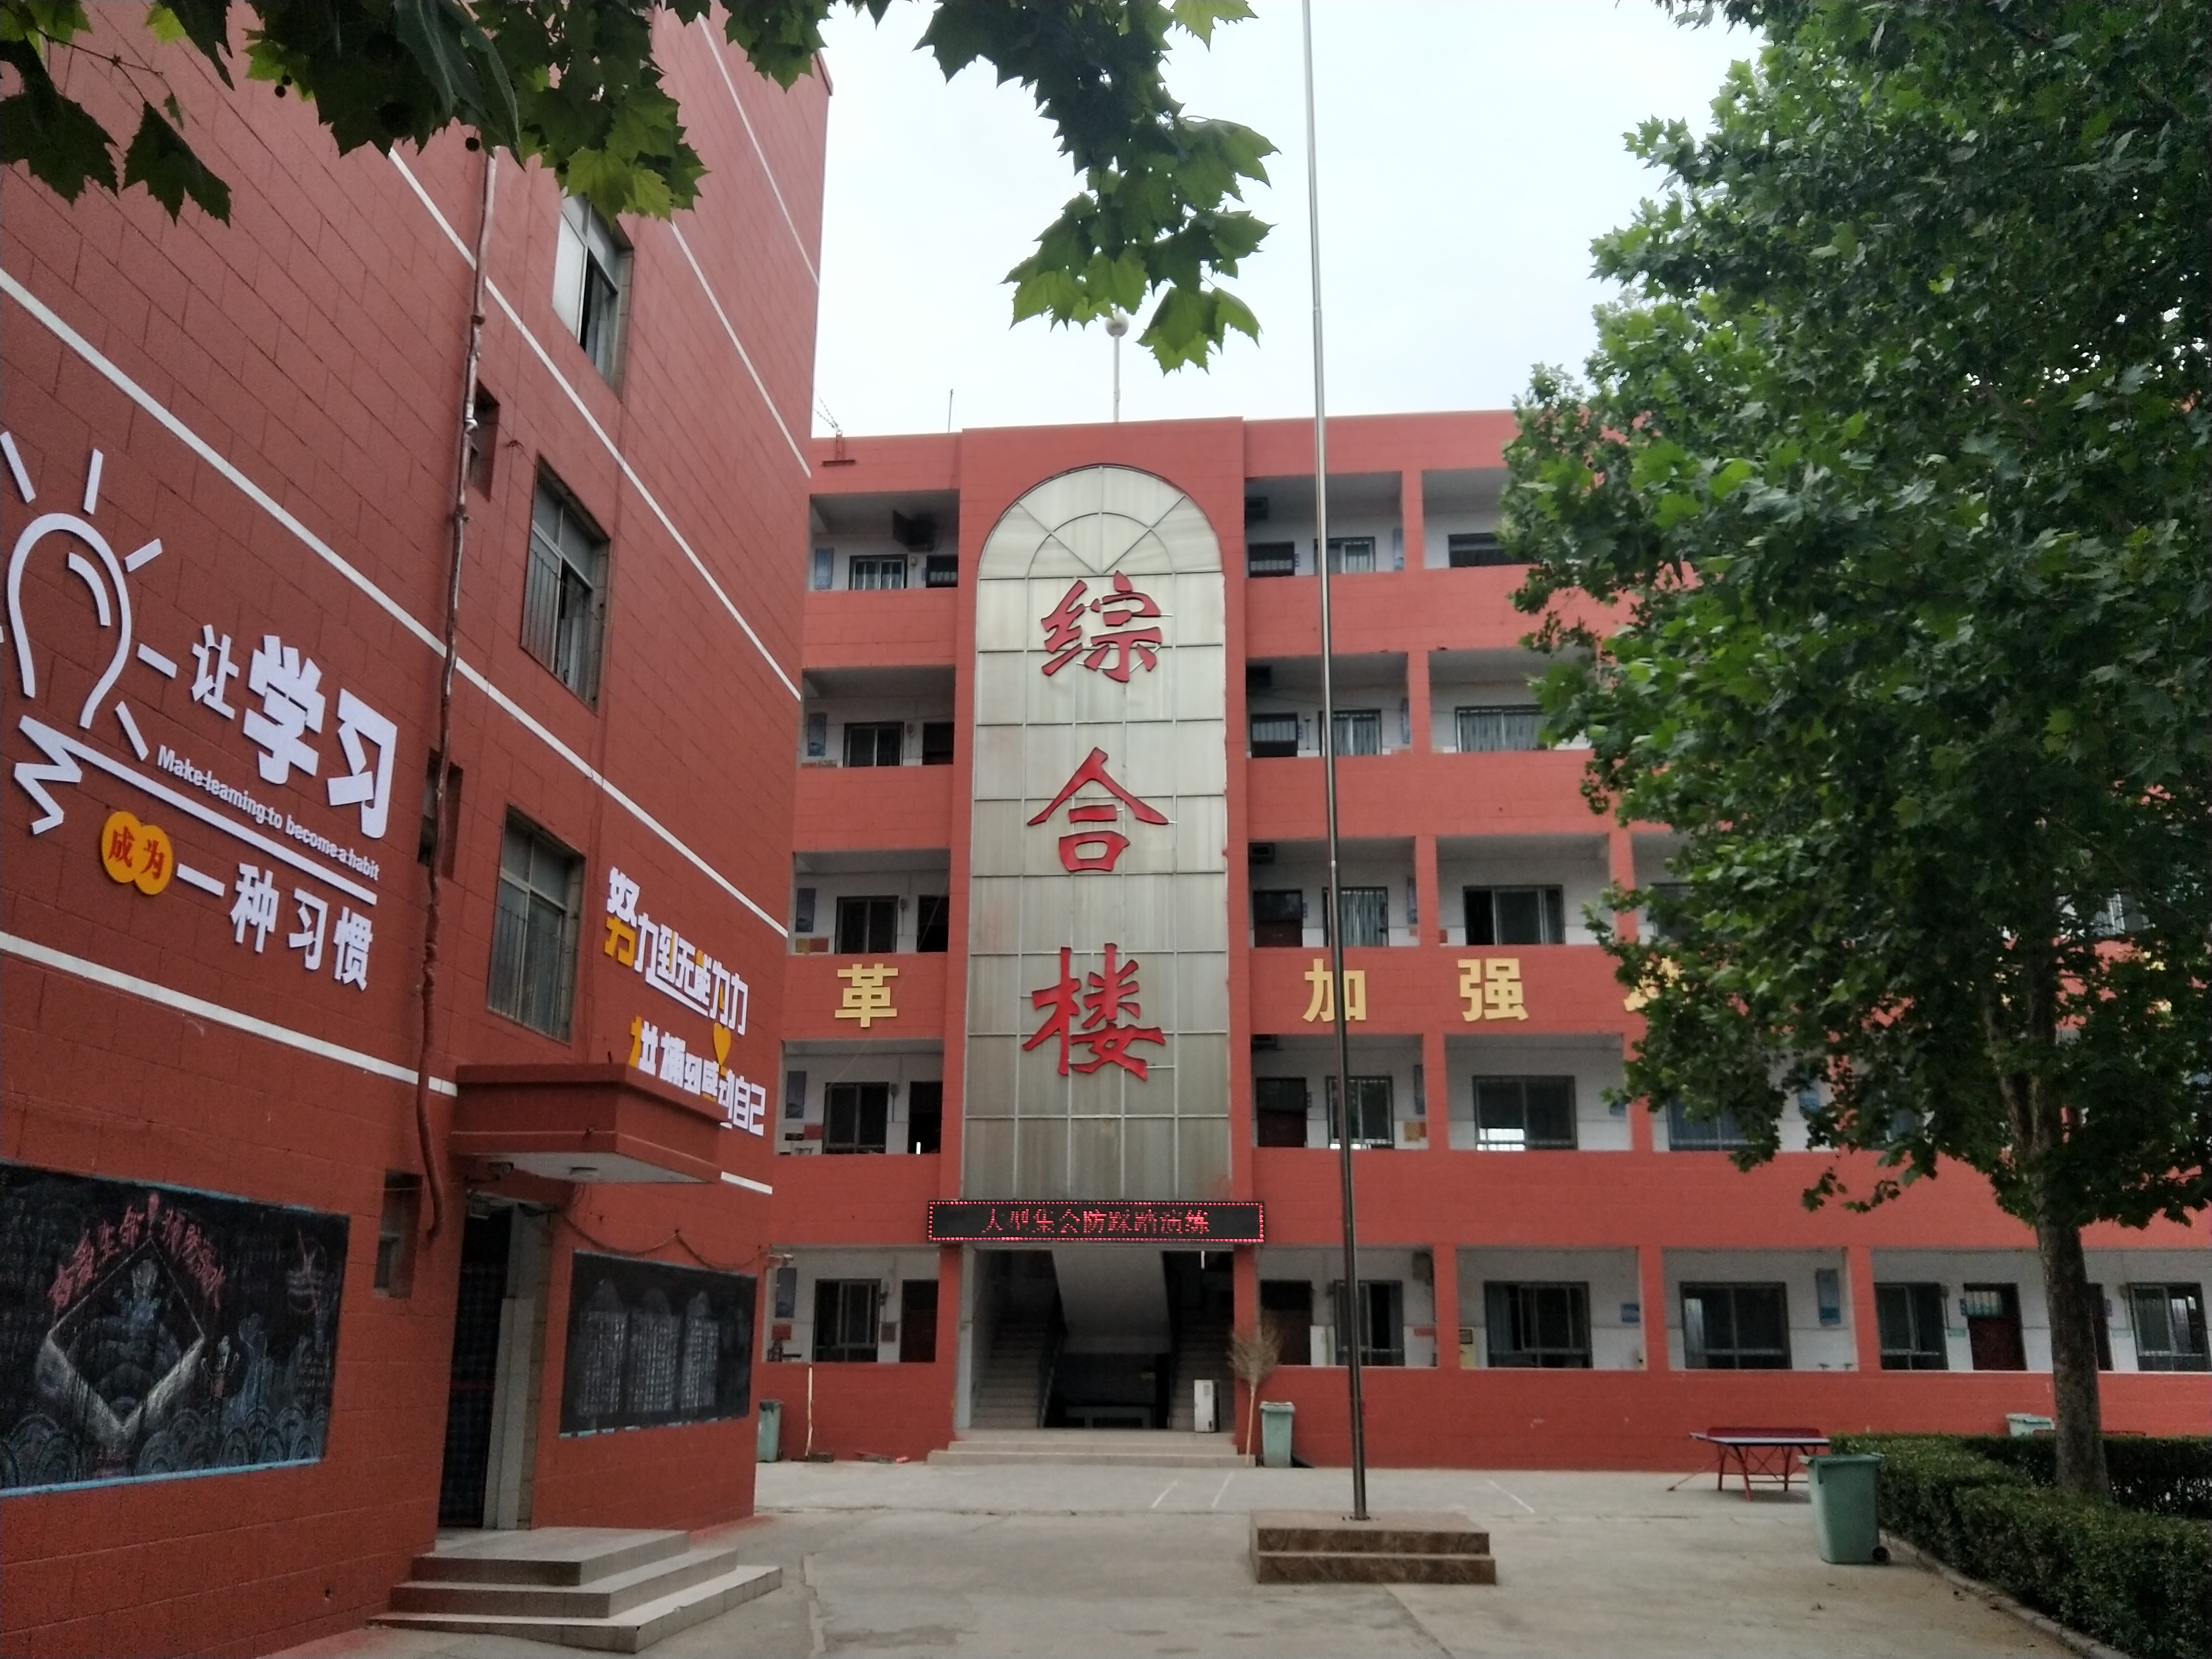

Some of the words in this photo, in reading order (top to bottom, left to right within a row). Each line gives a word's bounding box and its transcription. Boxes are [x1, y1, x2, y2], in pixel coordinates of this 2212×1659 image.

[156, 745, 203, 786] Make
[205, 770, 265, 824] learning
[268, 807, 282, 829] to
[285, 814, 337, 857] become
[338, 848, 348, 864] a
[348, 848, 380, 881] habit
[192, 624, 398, 839] 让学习
[1022, 570, 1170, 1081] 综合楼
[835, 963, 899, 1028] 革
